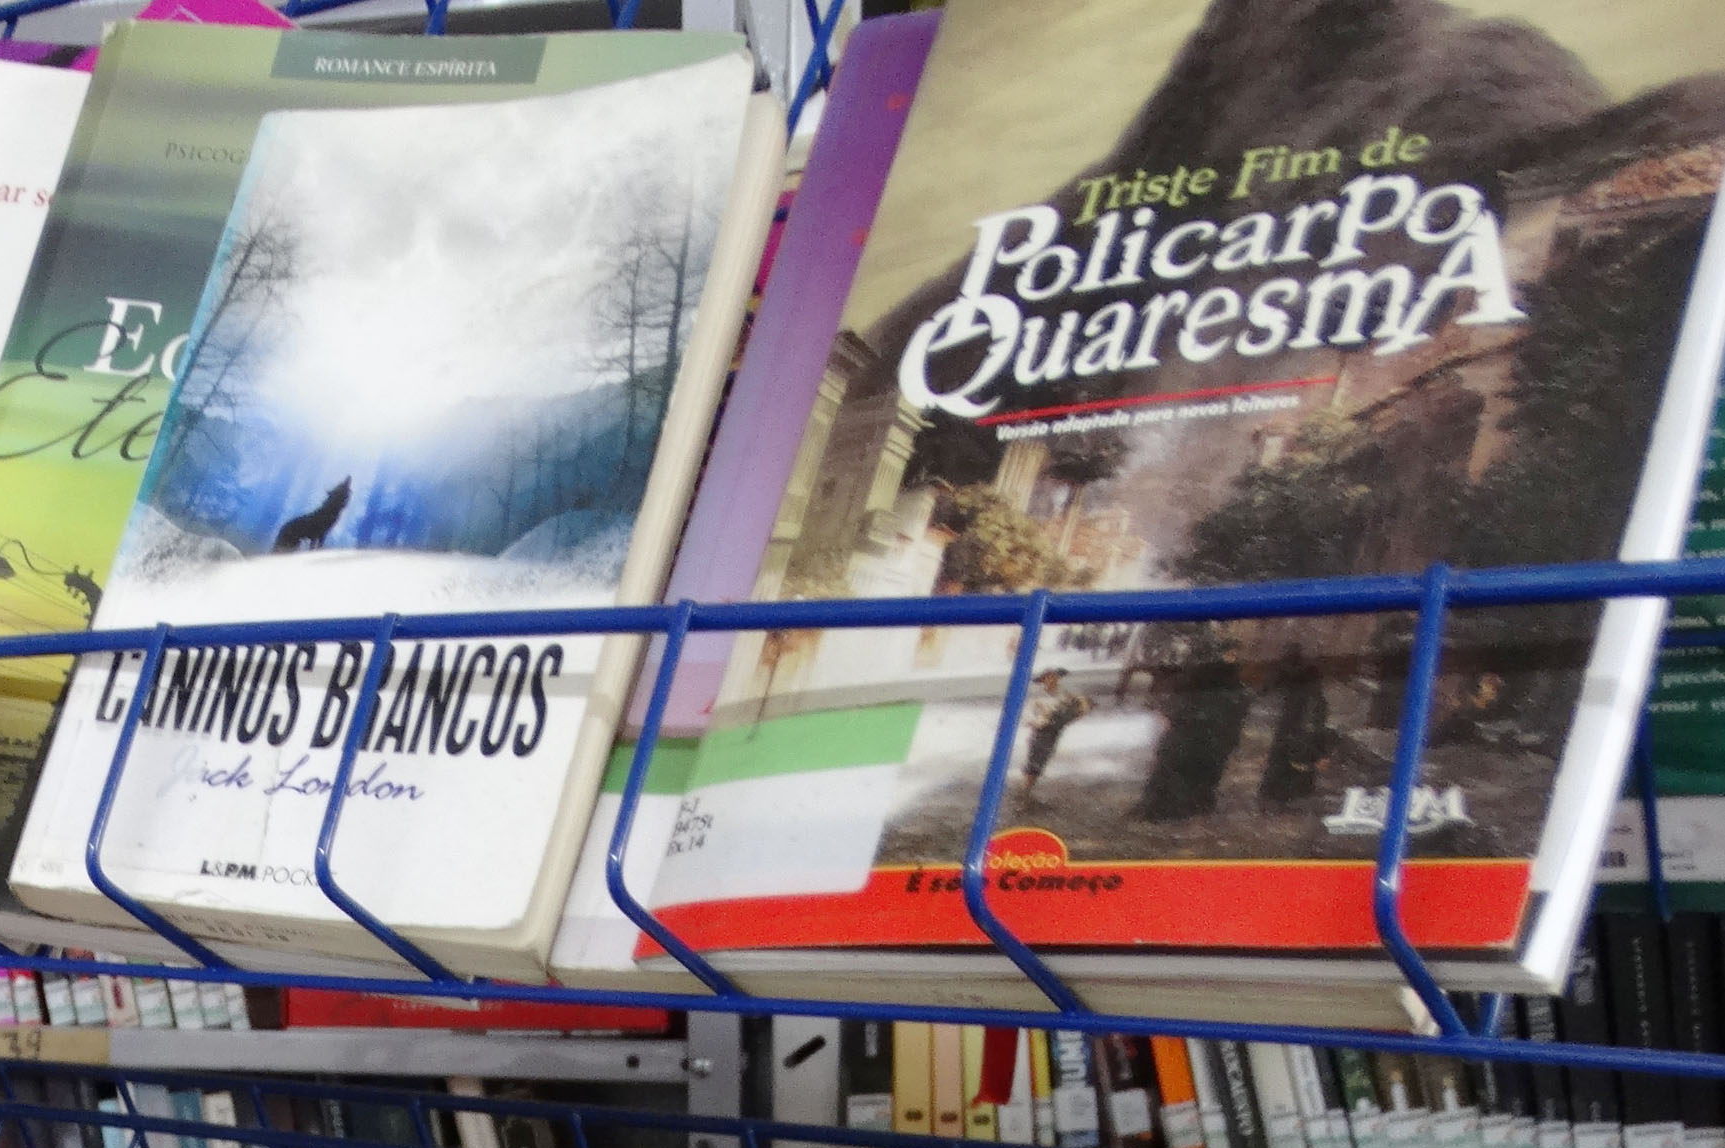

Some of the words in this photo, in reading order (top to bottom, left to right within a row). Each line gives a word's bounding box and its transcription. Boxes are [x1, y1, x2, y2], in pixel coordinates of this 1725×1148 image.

[313, 55, 408, 77] ROMANCE
[412, 57, 497, 79] ESPÍRITA
[1075, 163, 1216, 225] Triste
[1230, 144, 1342, 200] Fim
[1360, 124, 1432, 168] de
[1052, 410, 1131, 438] adaptada
[1133, 408, 1174, 432] para
[200, 860, 257, 880] L&PM
[982, 850, 1061, 872] oleção
[998, 869, 1124, 896] Começo
